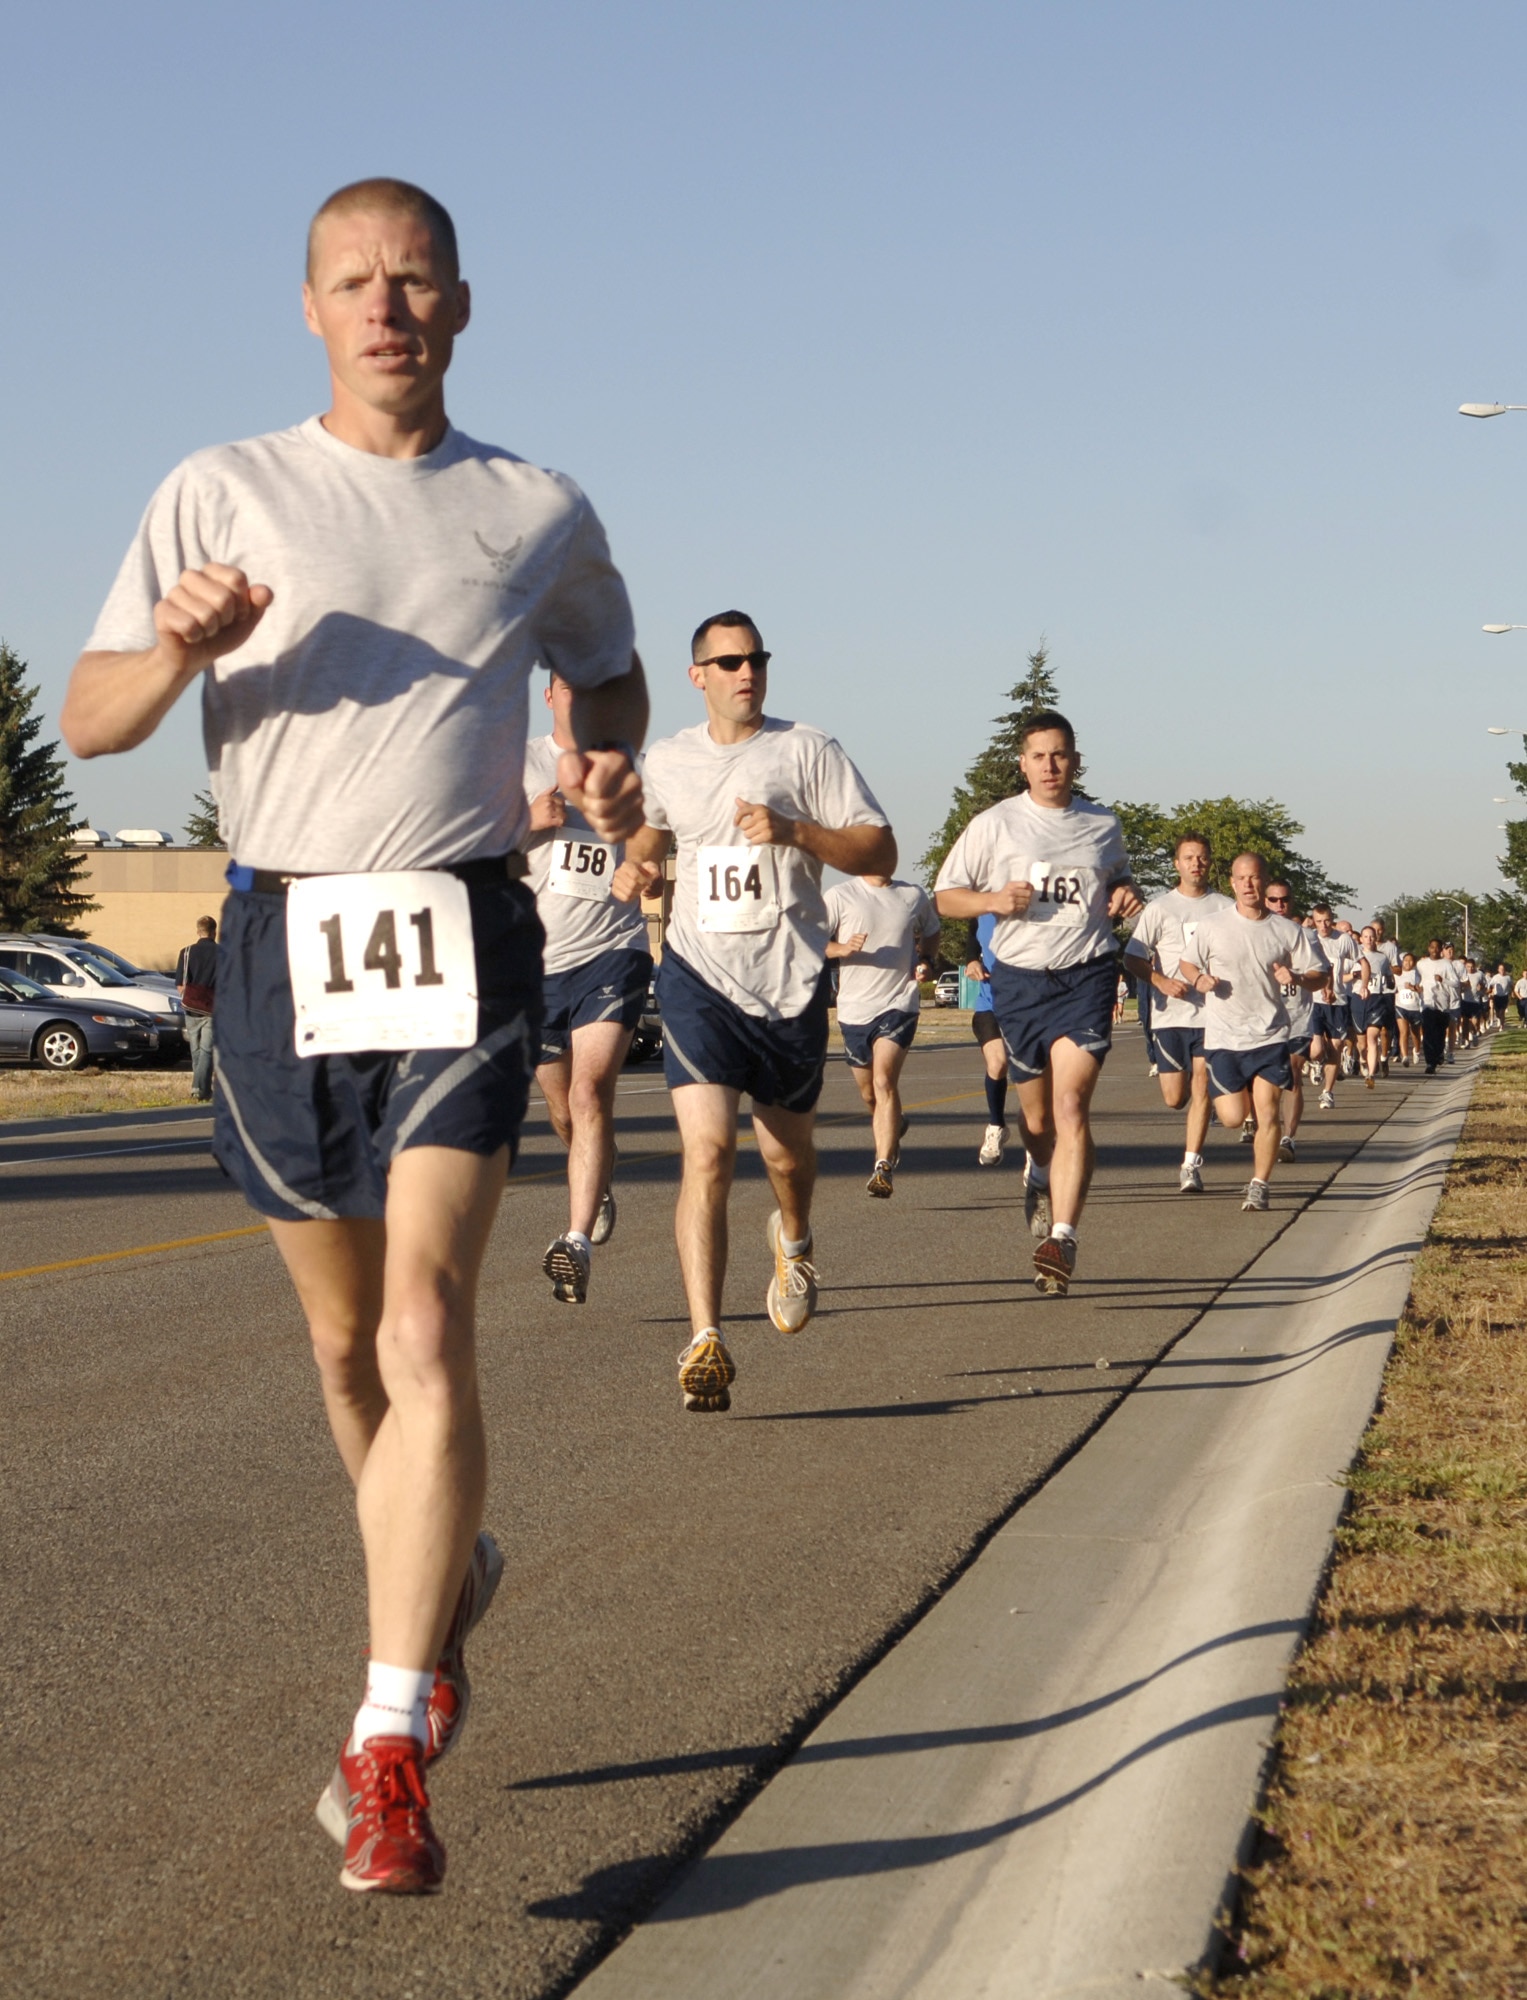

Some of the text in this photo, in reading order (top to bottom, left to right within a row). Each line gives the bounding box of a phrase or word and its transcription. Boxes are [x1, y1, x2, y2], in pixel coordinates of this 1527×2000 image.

[560, 841, 608, 877] 158
[708, 863, 763, 902] 164
[1038, 875, 1081, 905] 162
[319, 906, 444, 994] 141
